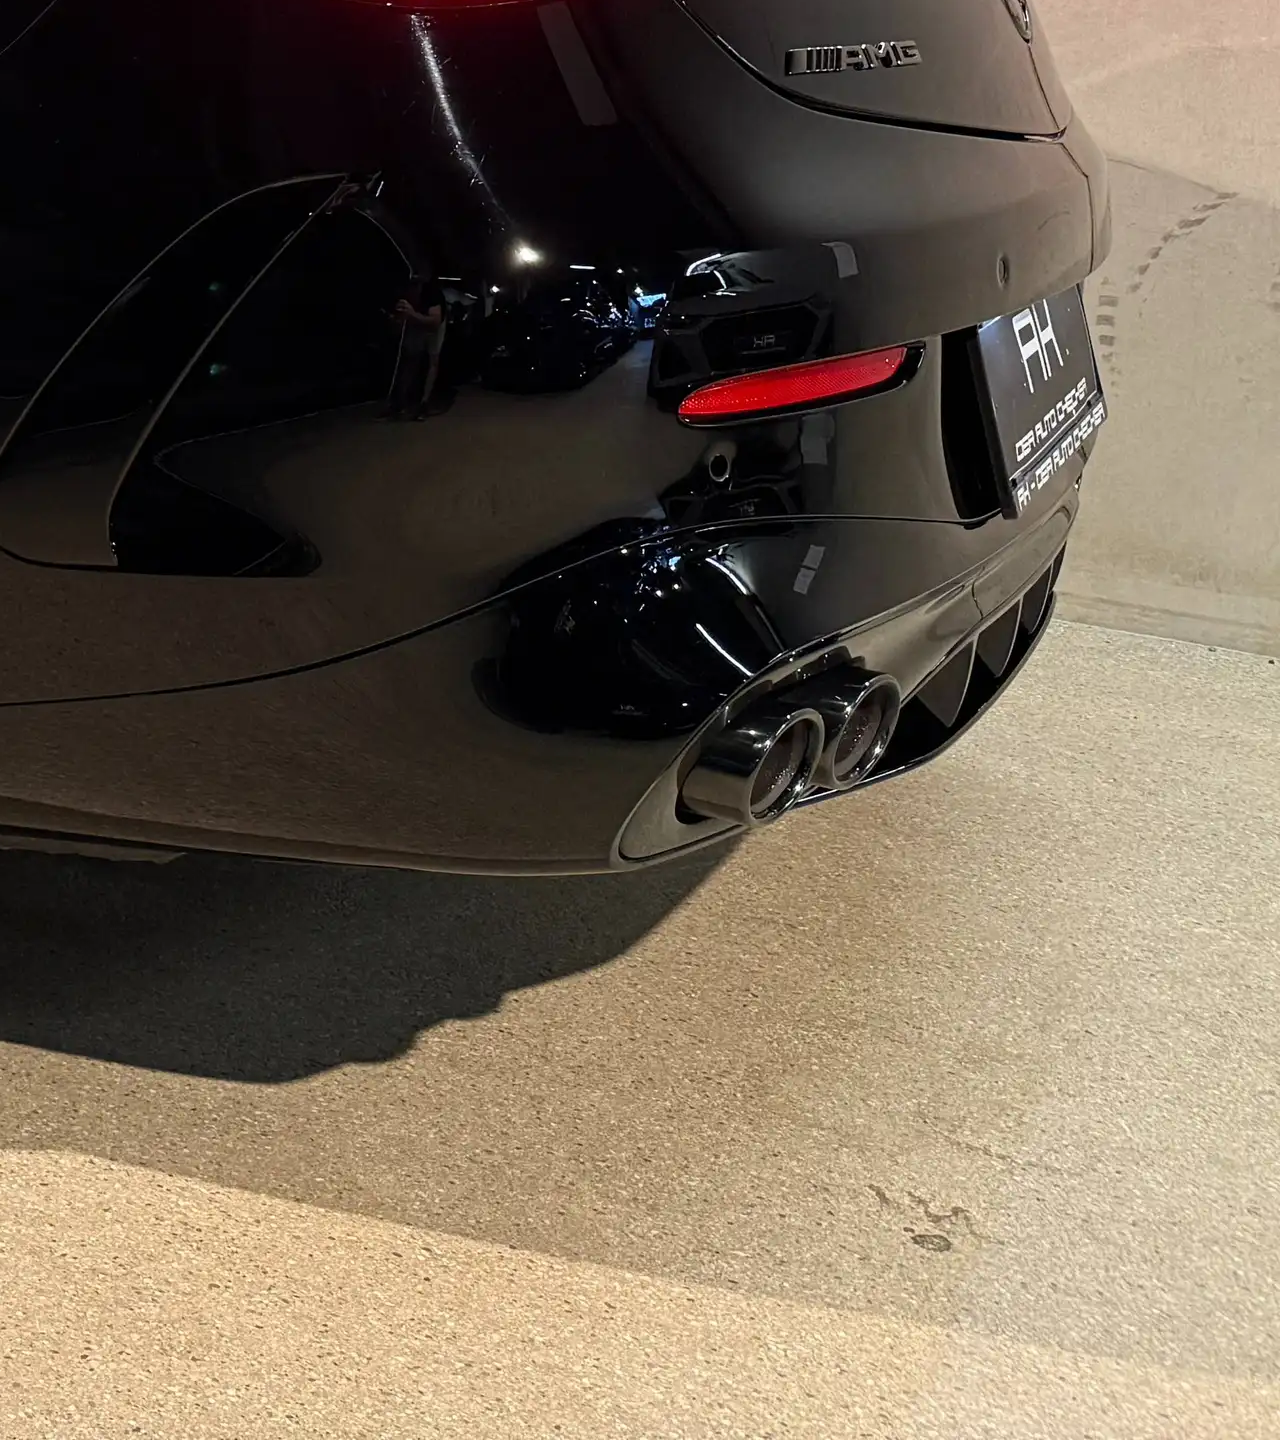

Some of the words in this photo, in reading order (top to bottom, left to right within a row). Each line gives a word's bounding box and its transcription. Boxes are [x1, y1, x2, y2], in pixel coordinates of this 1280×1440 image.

[1012, 299, 1064, 393] AK
[1015, 429, 1036, 461] DER
[1034, 407, 1057, 444] AUTO
[1035, 456, 1054, 490] DER
[1052, 435, 1075, 471] AUTO
